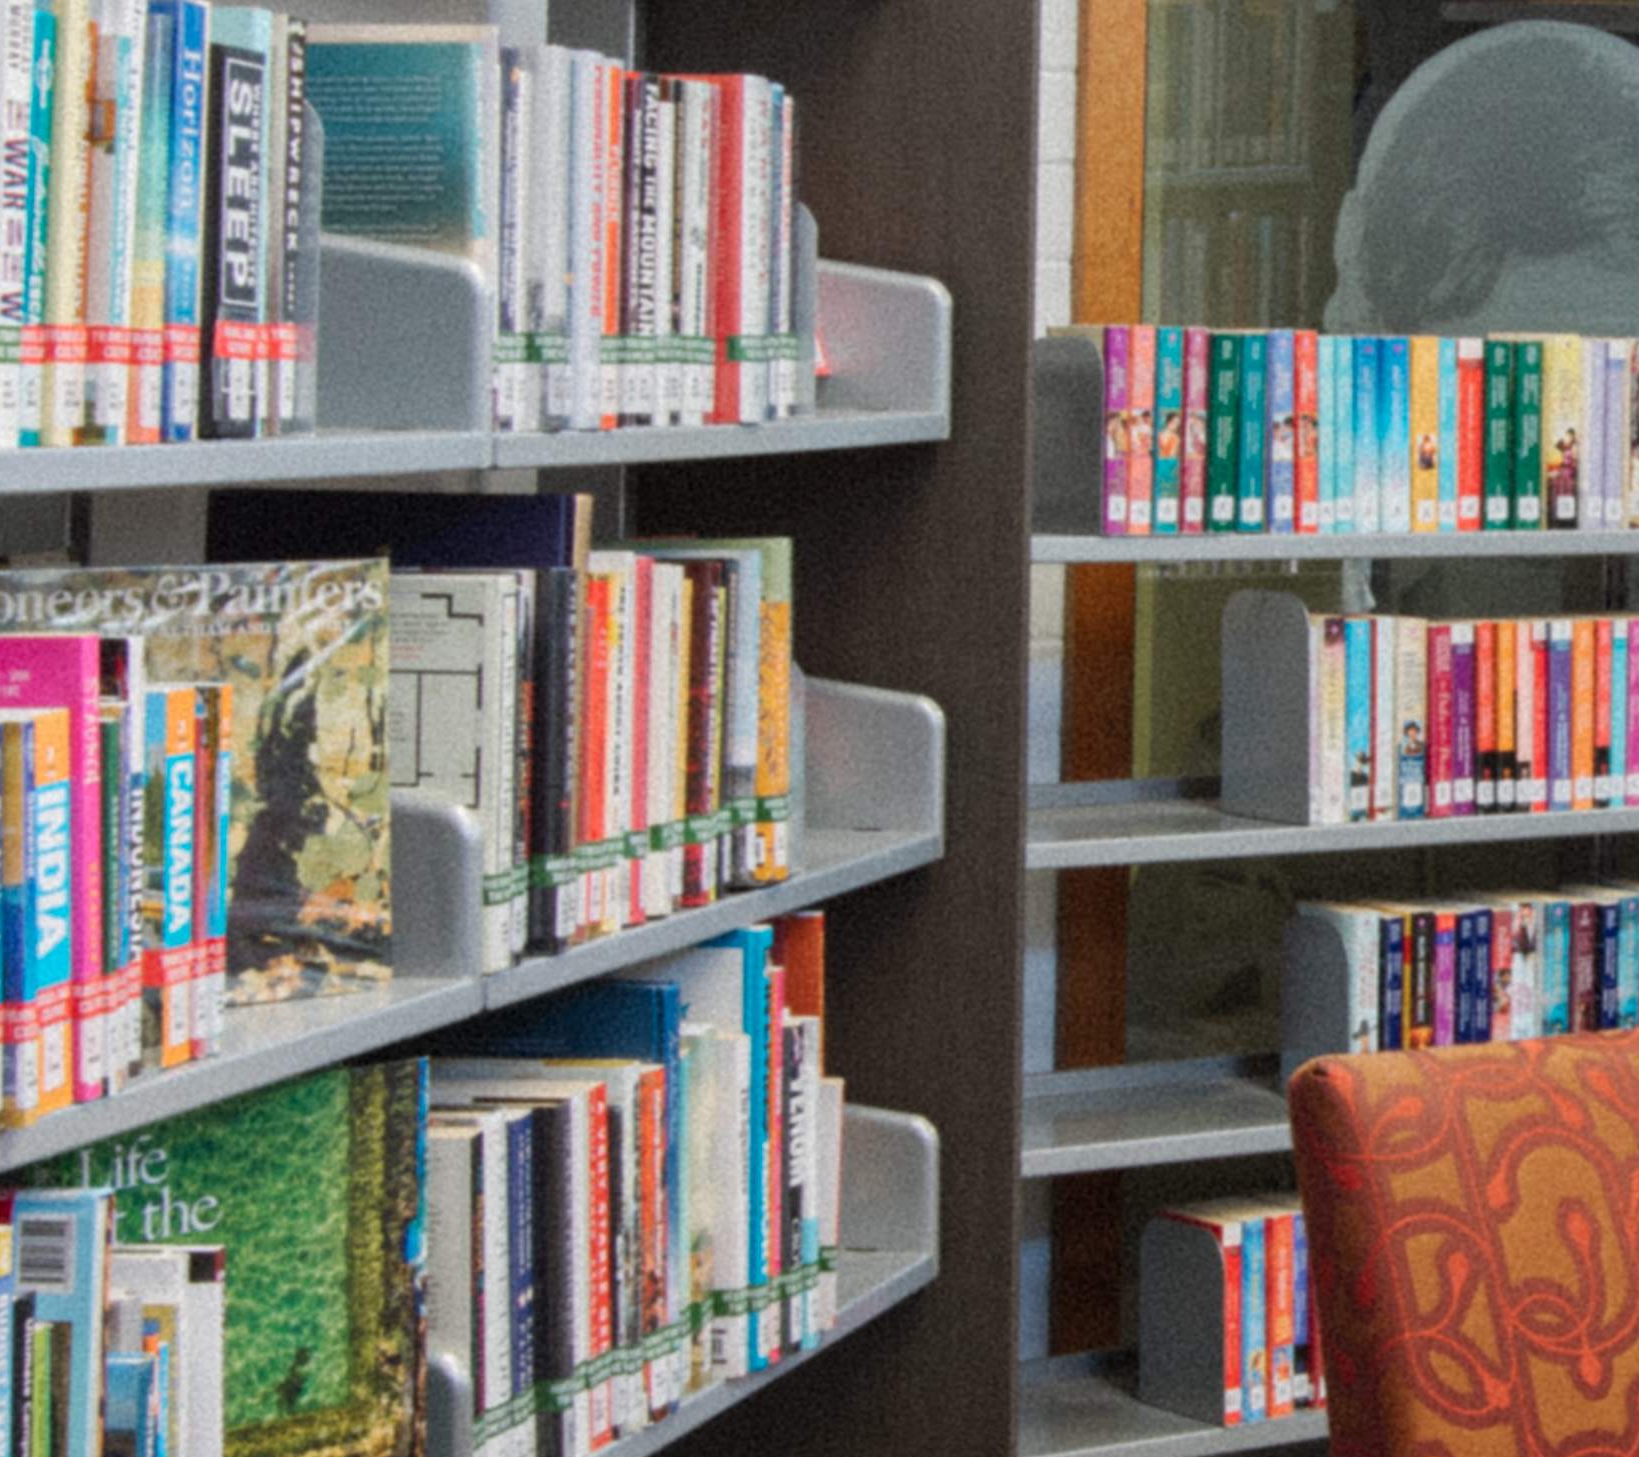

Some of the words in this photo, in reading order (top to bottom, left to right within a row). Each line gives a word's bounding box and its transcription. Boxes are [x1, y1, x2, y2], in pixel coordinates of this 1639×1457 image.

[0, 137, 28, 211] WAR
[176, 49, 202, 209] Horizon
[643, 83, 659, 168] FACING
[224, 78, 253, 288] SLEEP
[644, 175, 657, 206] THE
[638, 215, 655, 336] MOUNTAIN
[35, 790, 69, 958] INDIA
[165, 760, 195, 934] CANADA
[76, 1135, 171, 1193] Life
[140, 1189, 221, 1244] the
